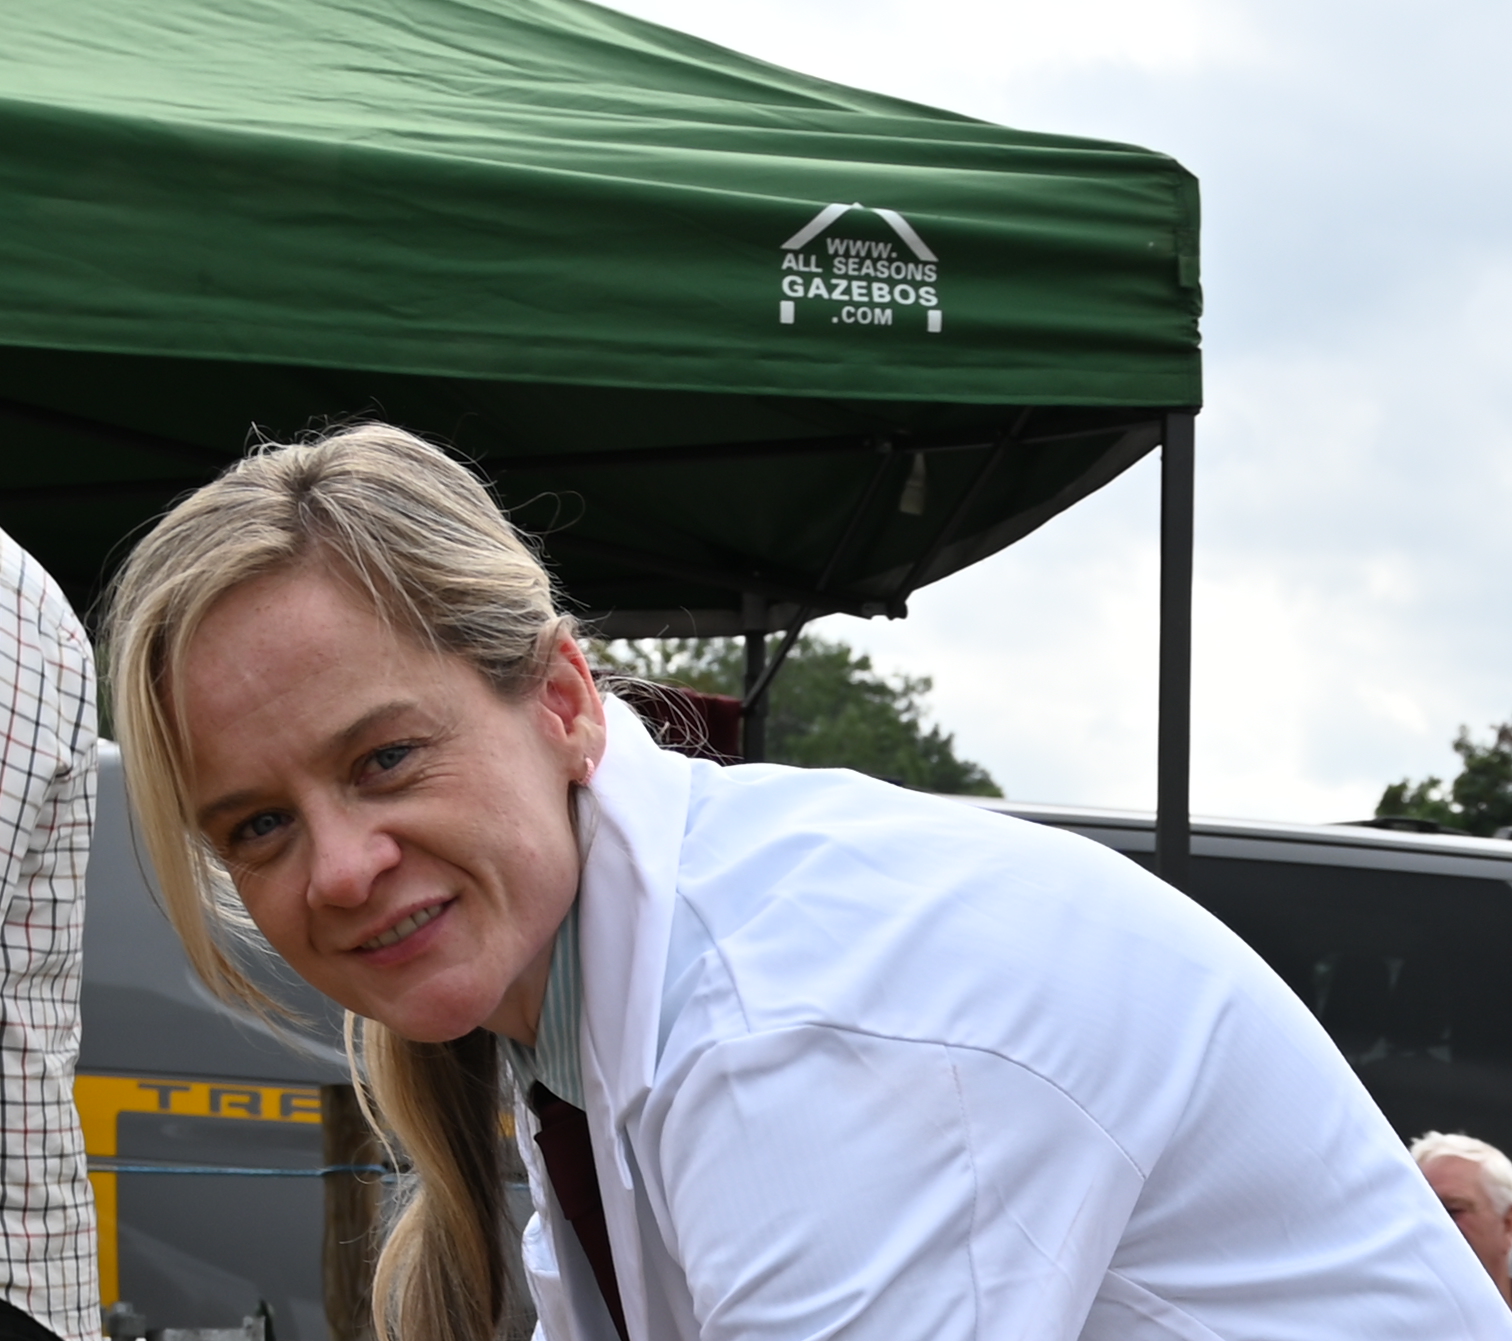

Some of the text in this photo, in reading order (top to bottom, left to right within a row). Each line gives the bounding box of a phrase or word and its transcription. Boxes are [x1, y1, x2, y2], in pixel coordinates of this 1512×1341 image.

[781, 253, 937, 282] ALL SEASONS
[781, 275, 938, 307] GAZEBOS
[831, 304, 893, 326] .COM
